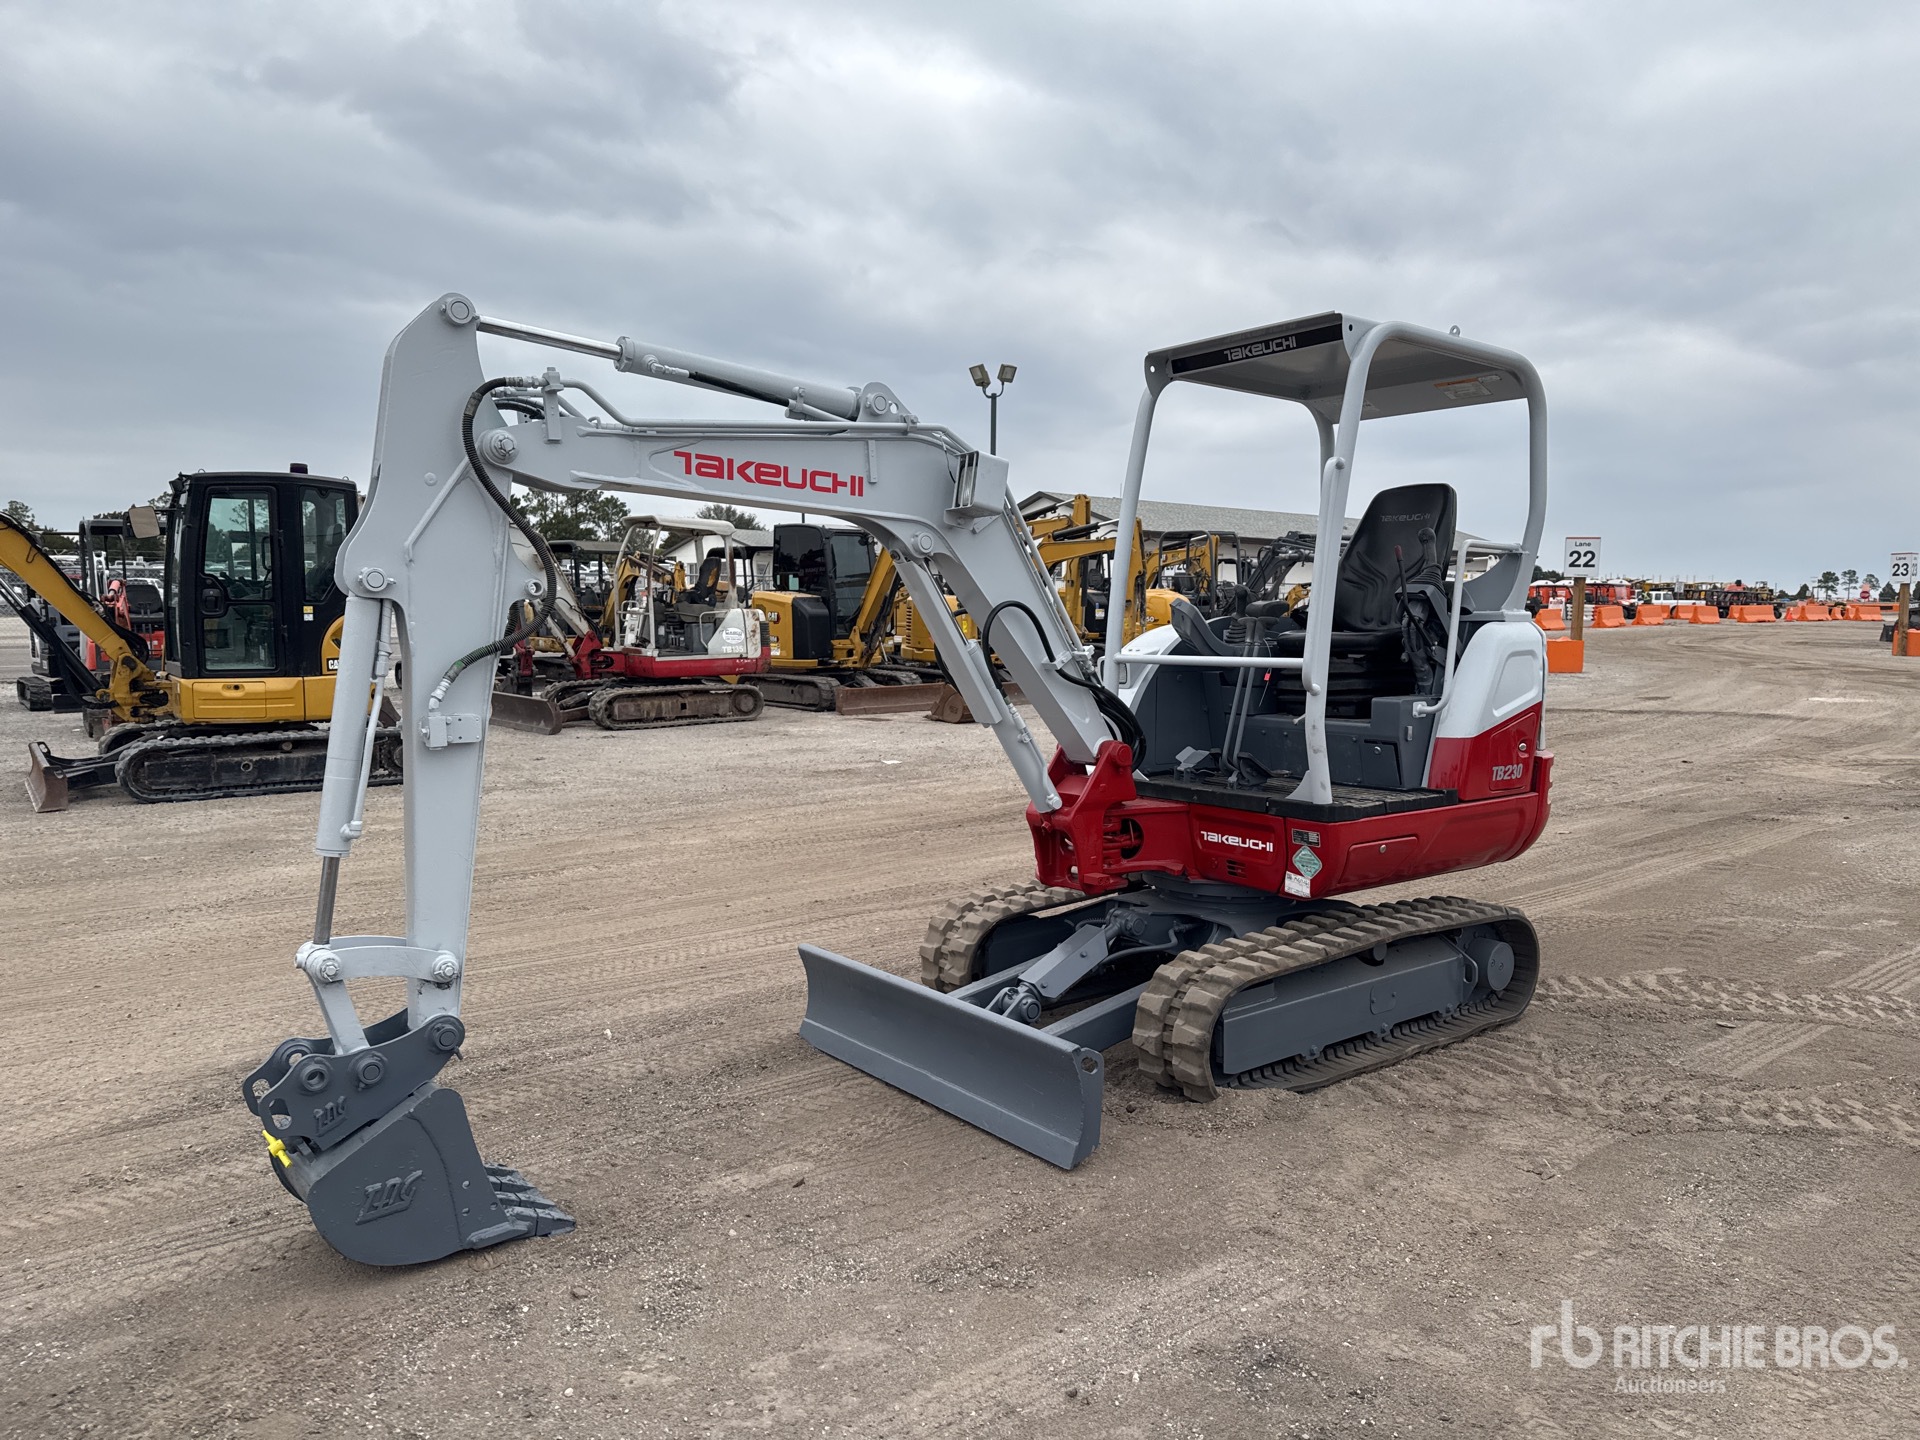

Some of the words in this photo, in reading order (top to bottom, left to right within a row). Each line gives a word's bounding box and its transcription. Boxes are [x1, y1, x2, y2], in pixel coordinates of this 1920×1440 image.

[1568, 550, 1596, 568] 22
[1892, 563, 1910, 577] 23
[328, 659, 340, 670] CA
[1492, 763, 1524, 781] TB230
